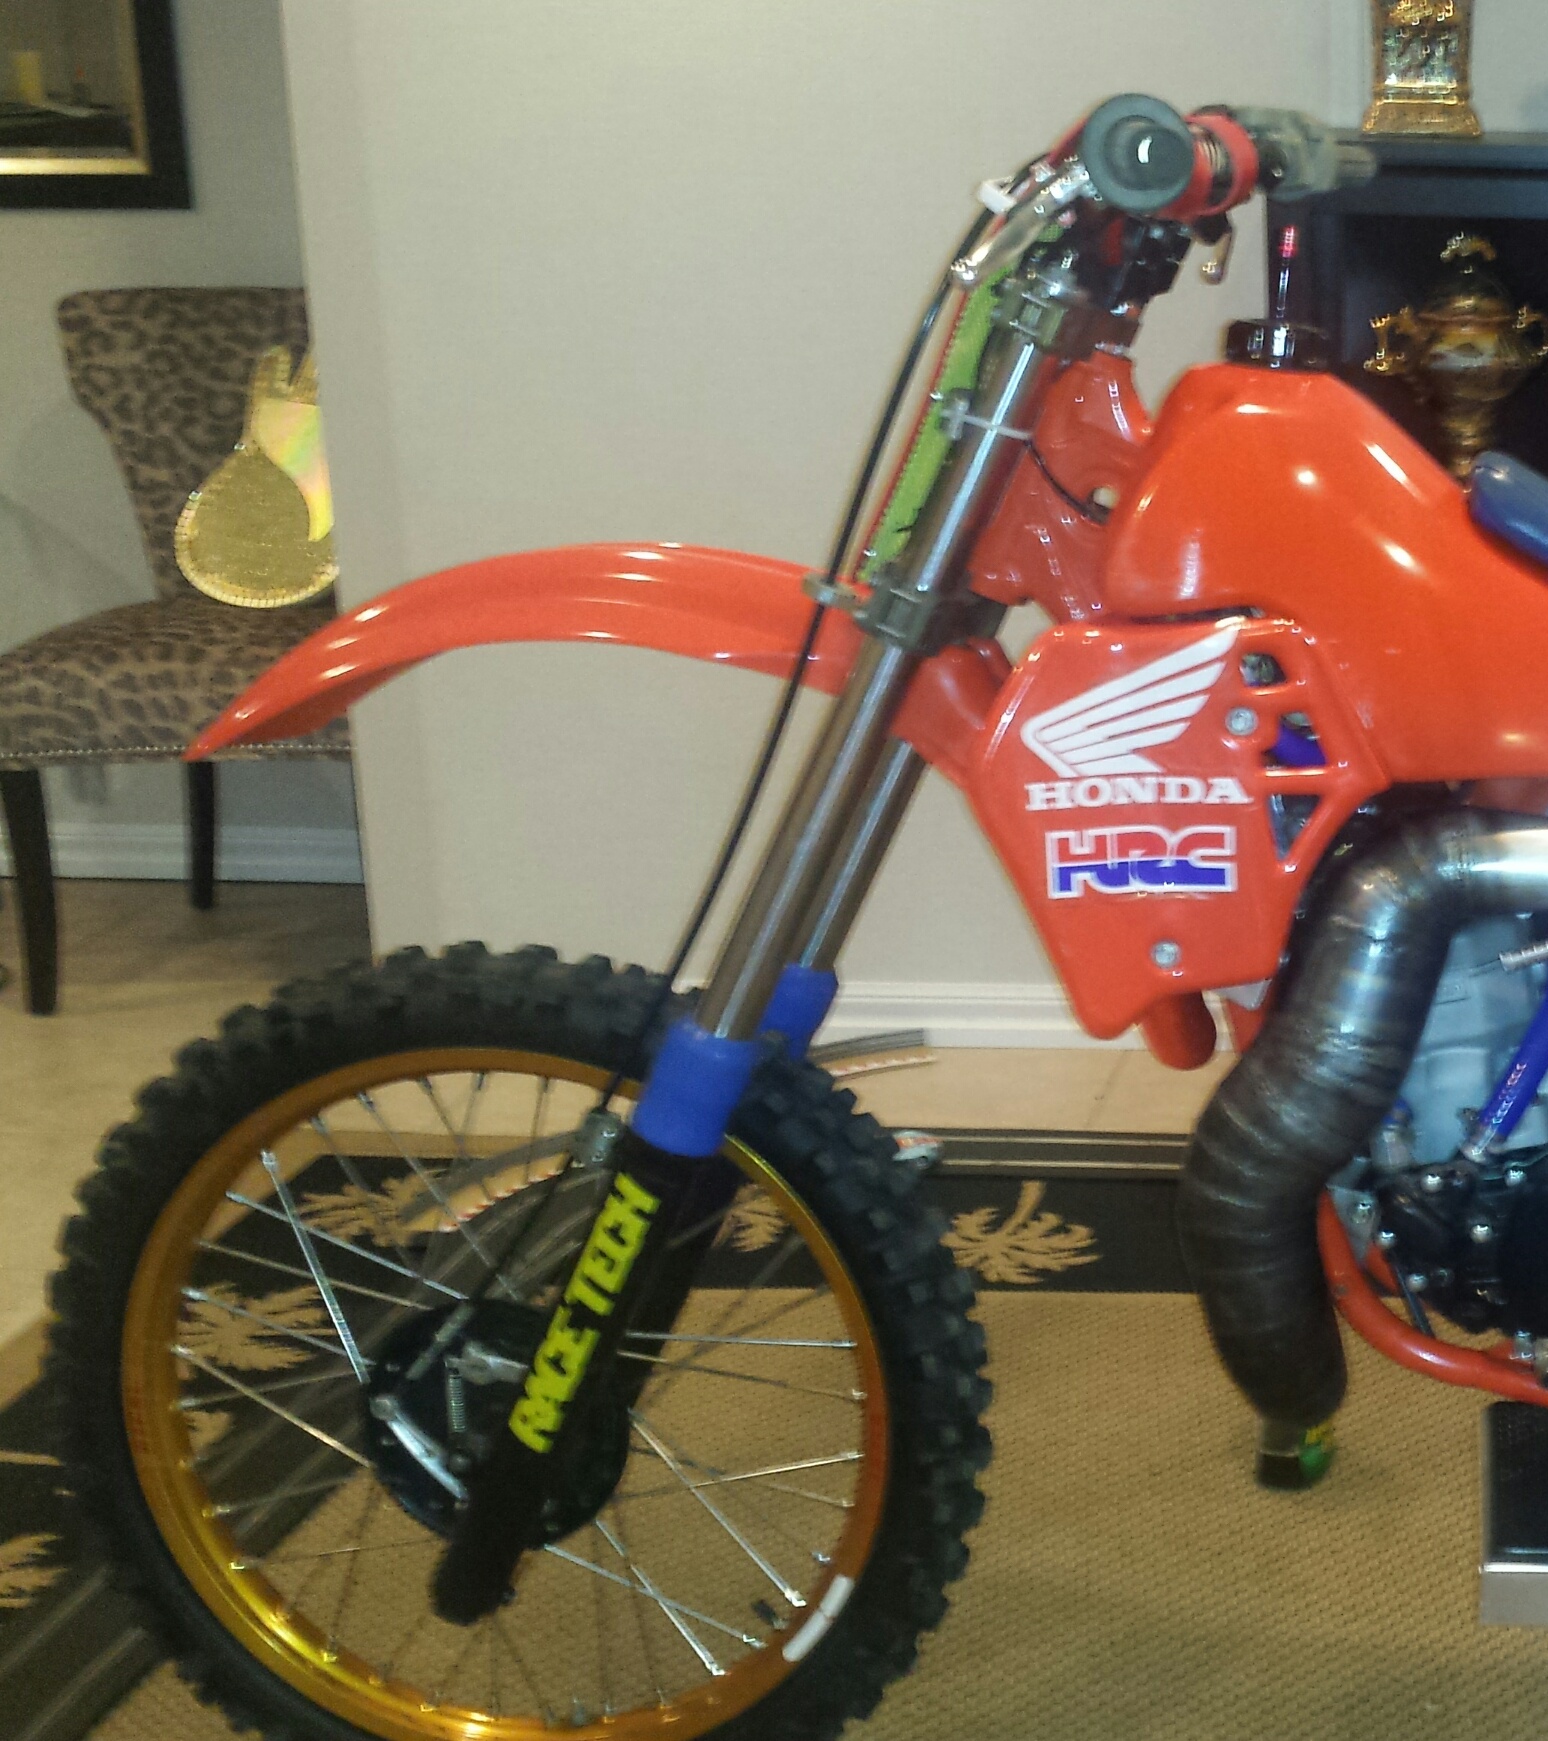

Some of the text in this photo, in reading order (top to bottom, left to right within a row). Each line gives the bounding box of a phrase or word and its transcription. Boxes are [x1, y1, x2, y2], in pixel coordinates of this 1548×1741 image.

[1024, 776, 1254, 811] HONDA
[1045, 825, 1238, 899] HRC
[508, 1171, 661, 1453] RACE TECH
